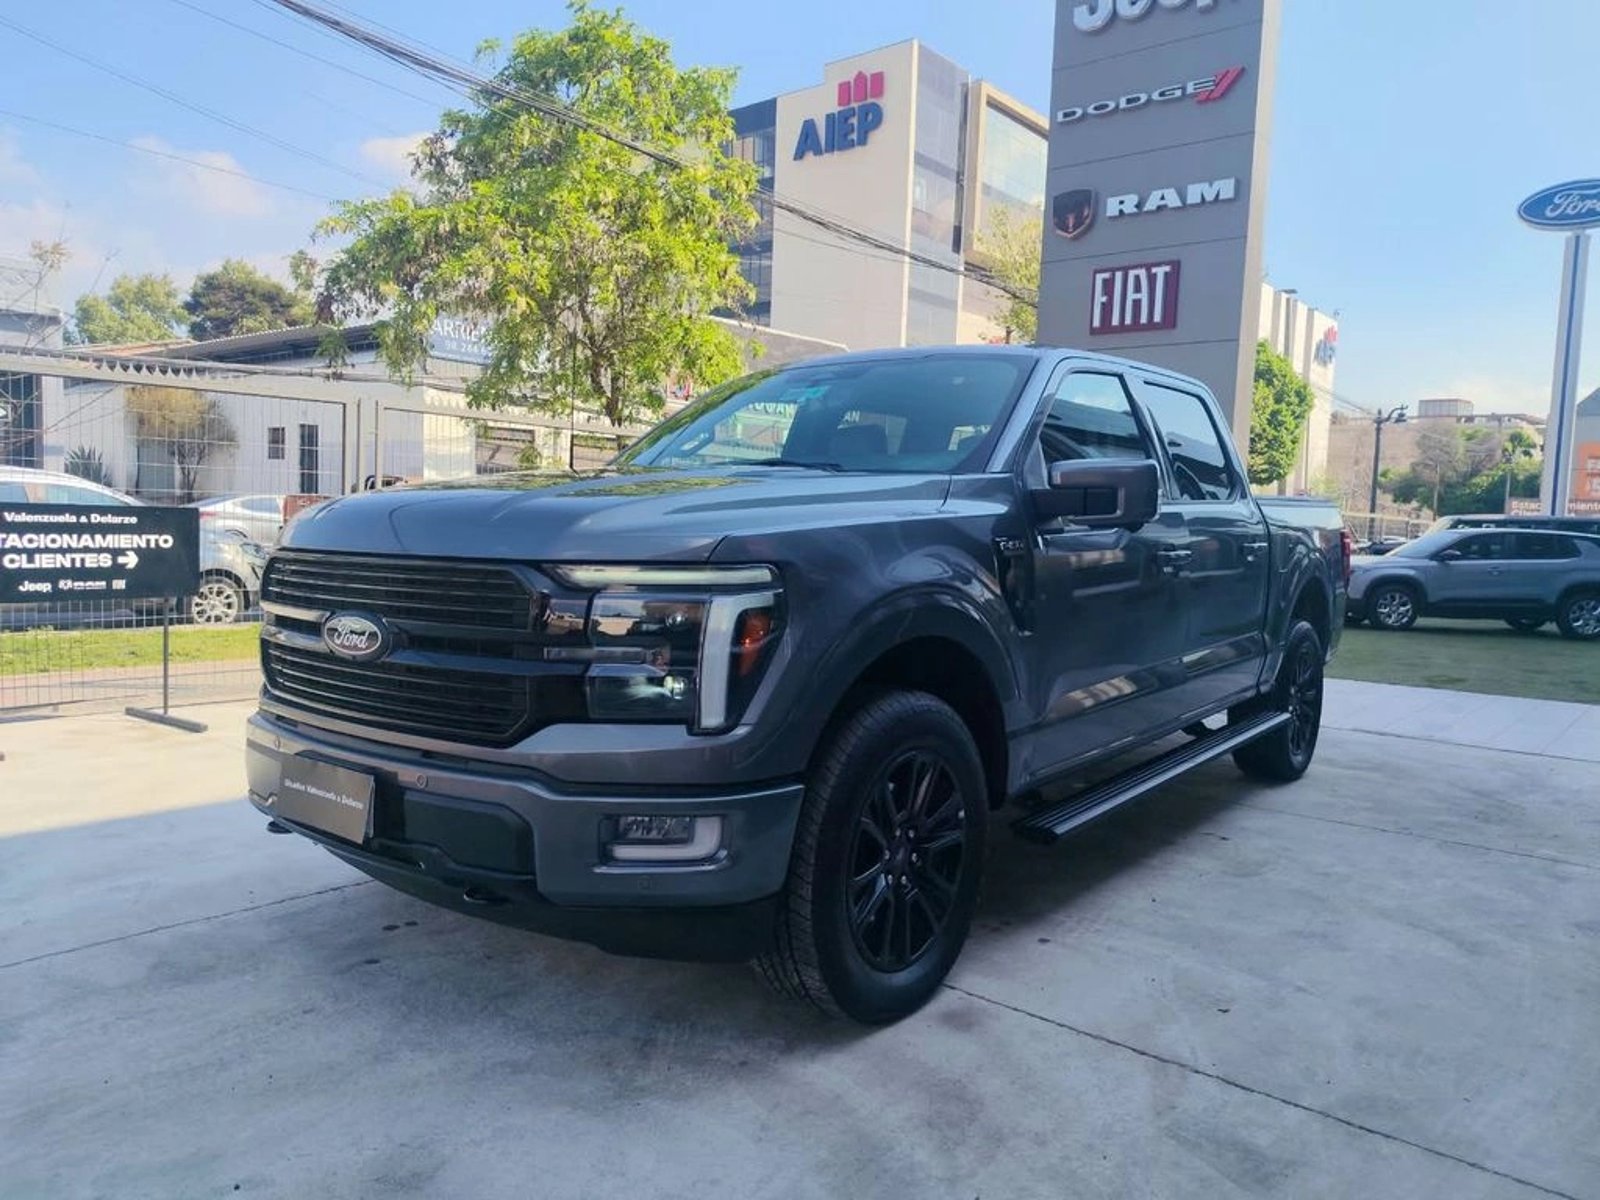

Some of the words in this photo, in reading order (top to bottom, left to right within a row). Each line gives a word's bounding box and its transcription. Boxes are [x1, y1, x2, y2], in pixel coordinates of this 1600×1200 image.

[1057, 76, 1216, 122] DODGE
[793, 101, 883, 161] AIEP
[1106, 177, 1236, 217] RAM
[1092, 264, 1172, 328] FIAT
[4, 511, 77, 523] Valenzuela
[90, 513, 138, 524] Delarze
[3, 553, 113, 569] CLIENTES
[333, 619, 370, 649] Ford
